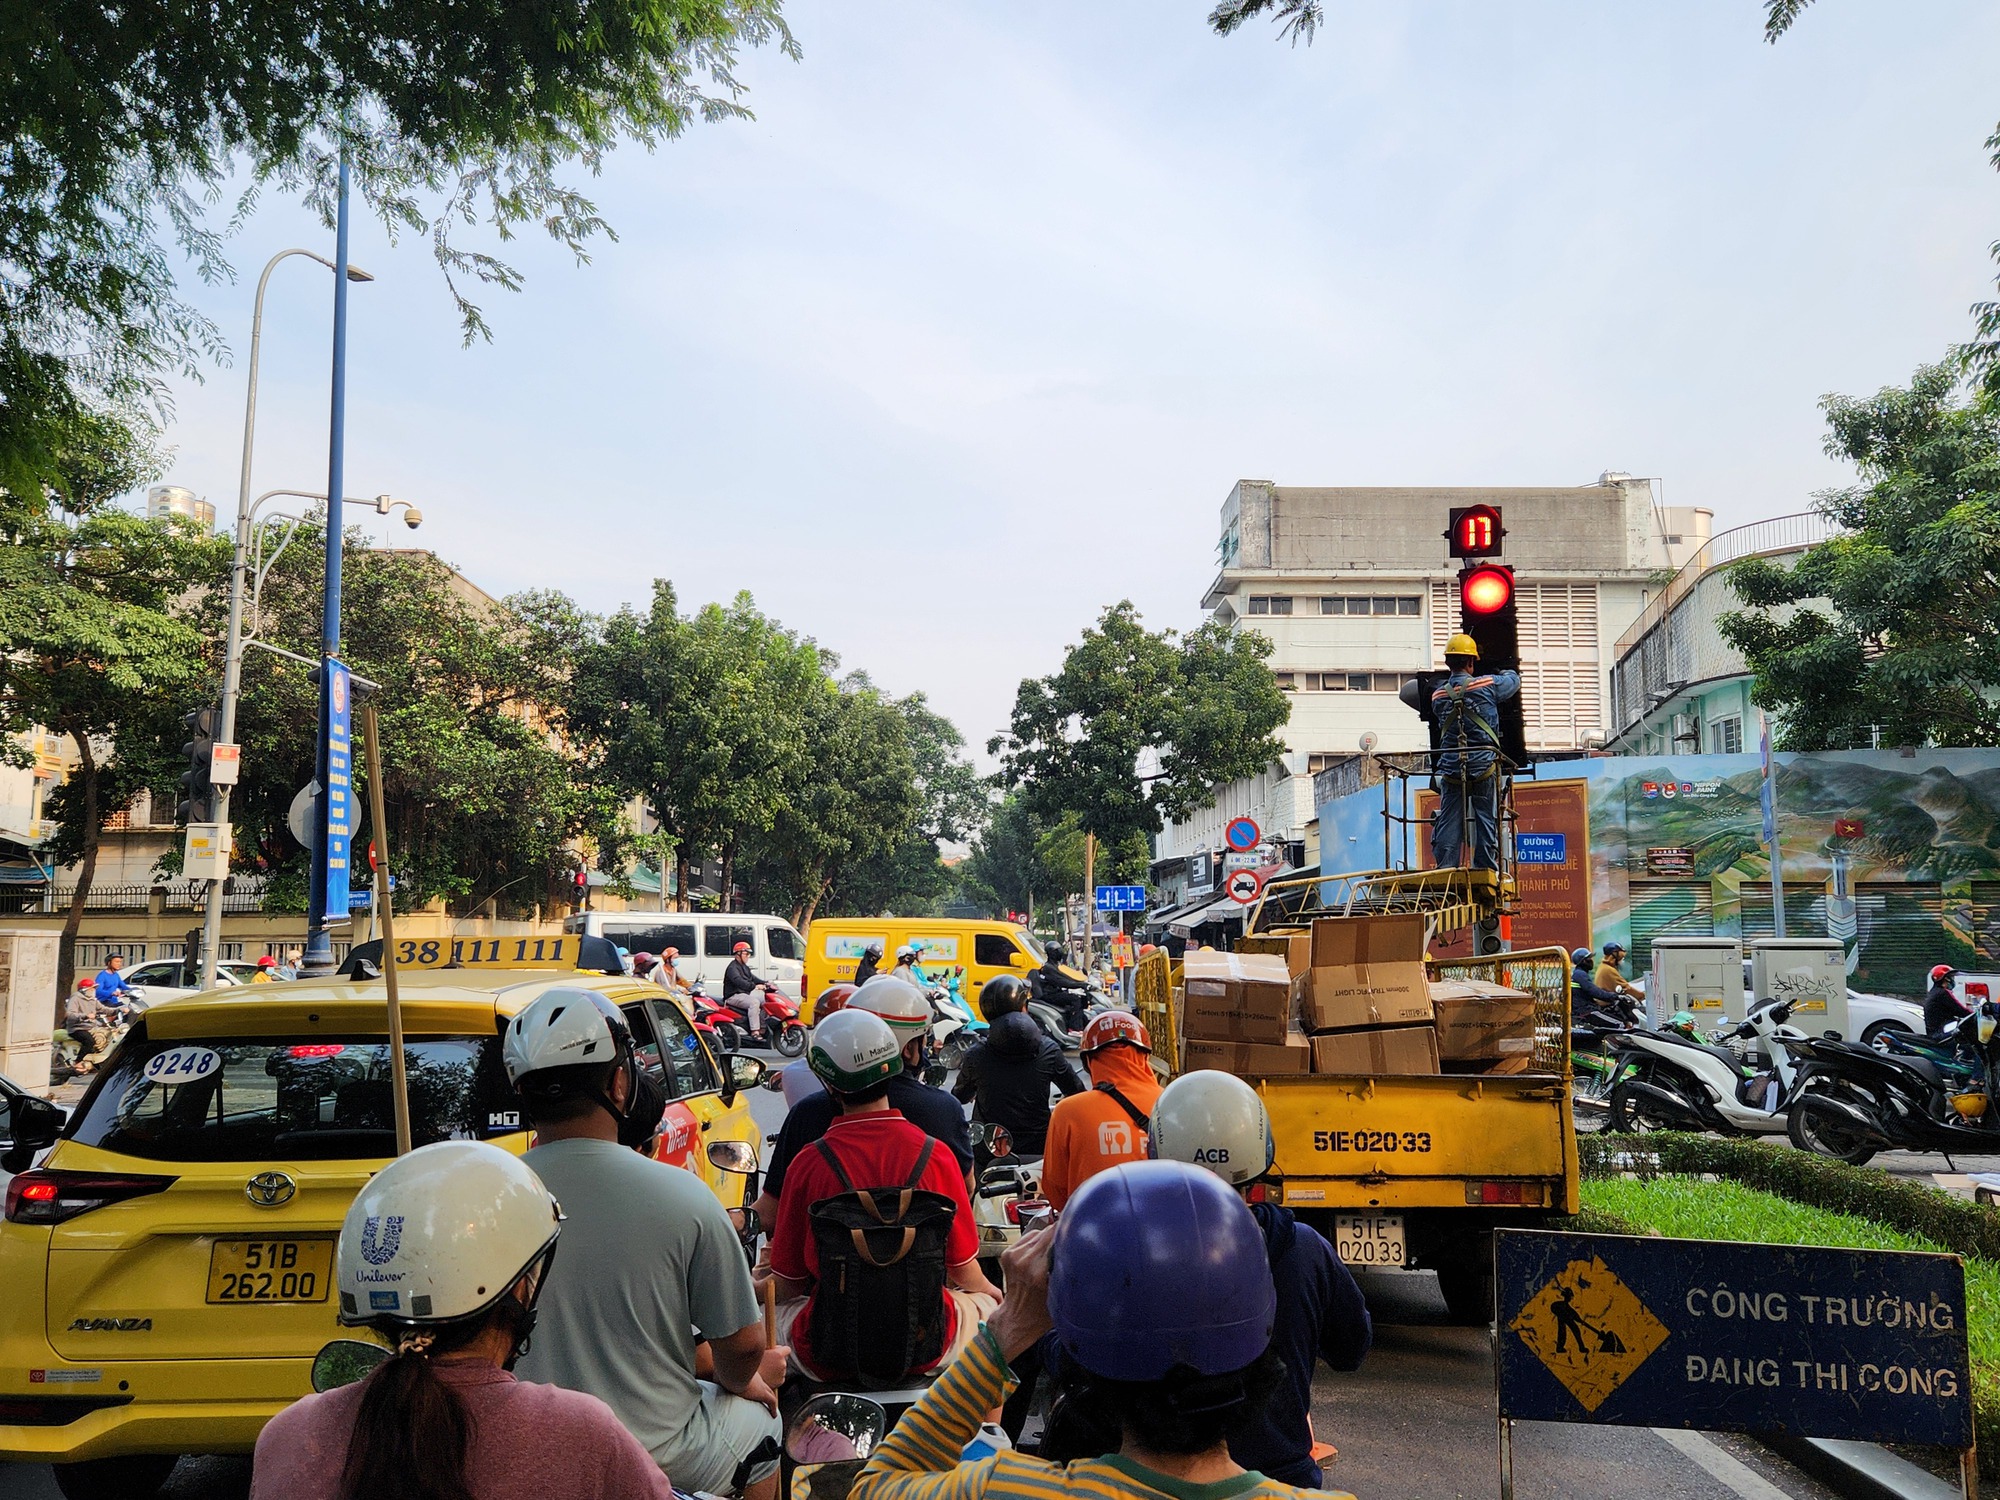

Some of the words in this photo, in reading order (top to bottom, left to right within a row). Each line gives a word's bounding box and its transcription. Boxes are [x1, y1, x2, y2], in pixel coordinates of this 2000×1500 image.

[1468, 516, 1492, 546] 17
[1523, 836, 1555, 846] ĐƯỜNG
[1528, 850, 1543, 863] THỊ
[1545, 848, 1564, 861] SÁU
[1551, 874, 1571, 891] PHỐ
[1511, 901, 1545, 910] OCATIONAL
[1565, 911, 1578, 919] CITY
[396, 940, 441, 964] 38
[453, 938, 501, 963] 111
[512, 938, 563, 962] 111
[150, 1050, 213, 1075] 9248
[489, 1111, 520, 1126] HT
[1193, 1148, 1230, 1164] ACB
[1352, 1217, 1388, 1240] 51E
[245, 1243, 298, 1269] 51B
[1339, 1241, 1403, 1263] 020.33
[356, 1269, 406, 1283] Unilever
[219, 1272, 315, 1300] 262.00
[1686, 1282, 1788, 1322] CÔNG
[1799, 1290, 1955, 1331] TRƯỜNG
[67, 1317, 153, 1332] AVANZA
[1686, 1355, 1781, 1387] ĐANG
[1792, 1360, 1848, 1392] THI
